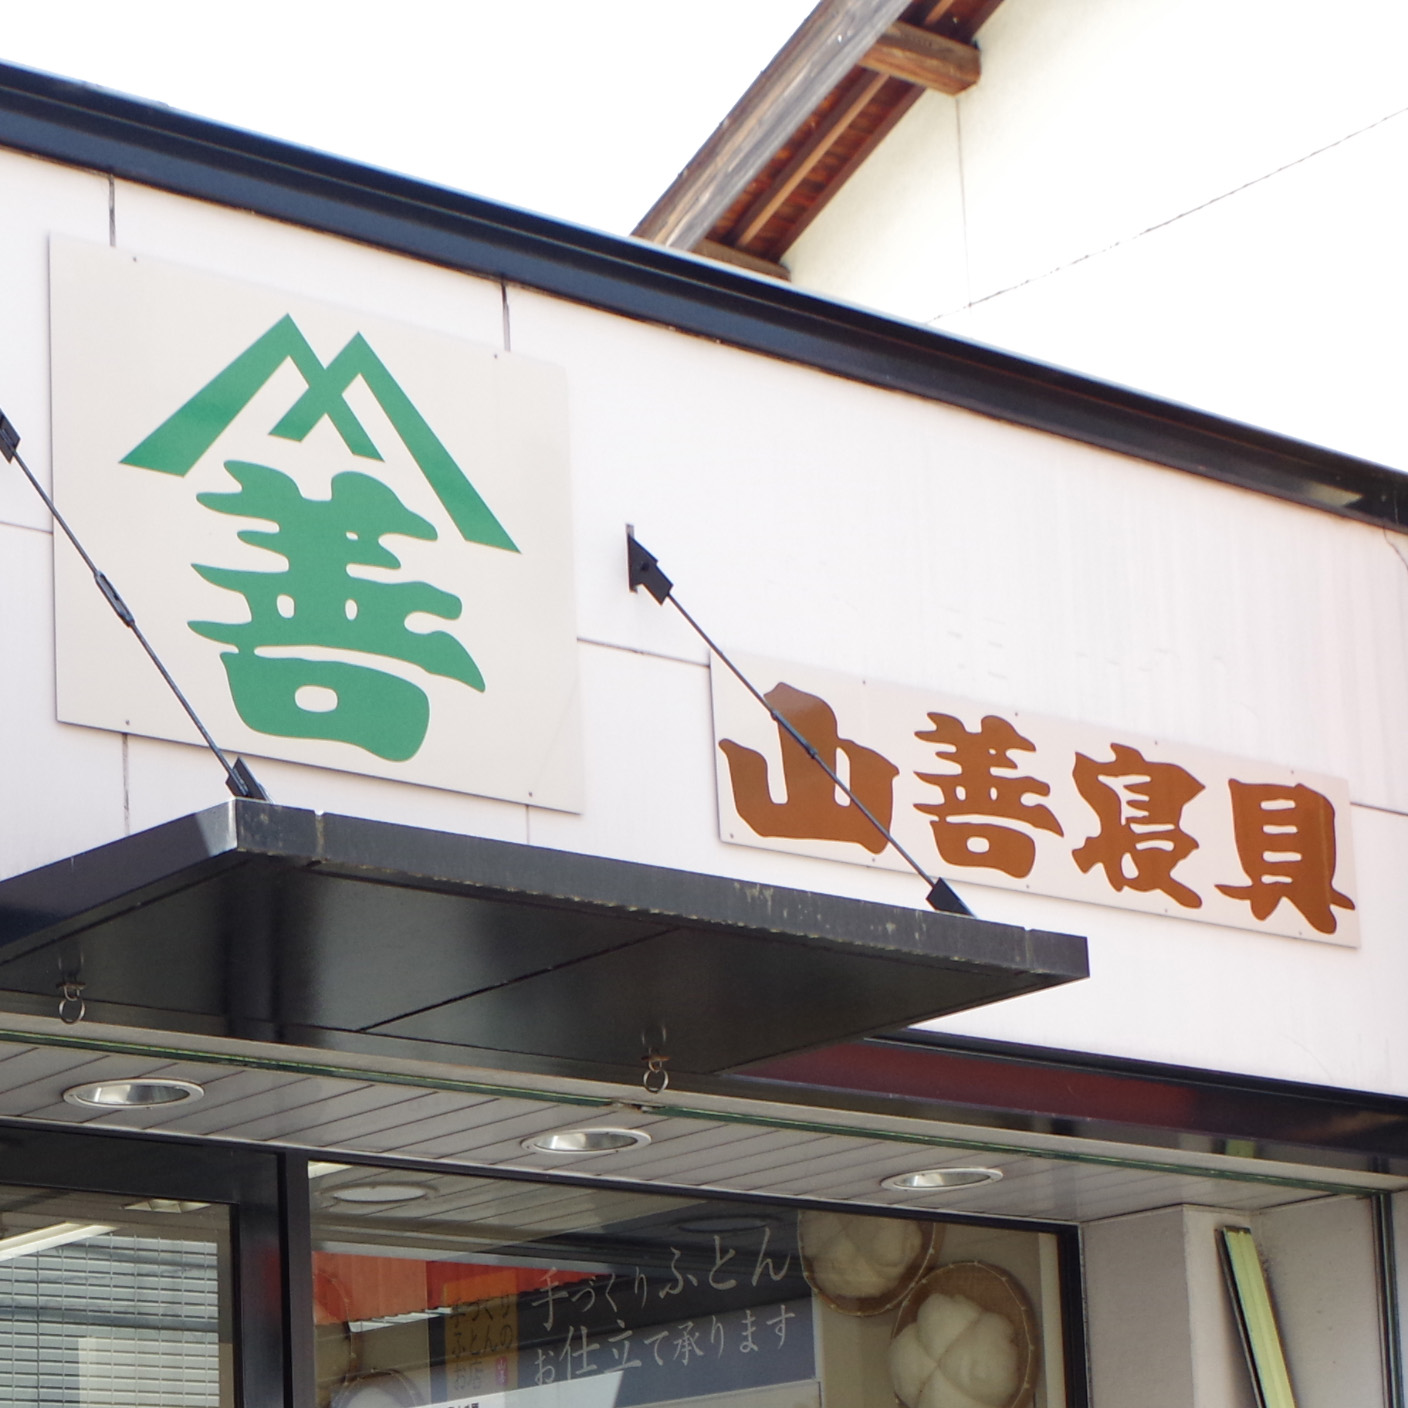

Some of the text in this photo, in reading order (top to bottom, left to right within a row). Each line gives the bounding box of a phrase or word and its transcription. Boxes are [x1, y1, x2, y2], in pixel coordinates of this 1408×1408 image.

[719, 682, 1355, 935] 山善寝具
[533, 1227, 791, 1331] 手づくりふとん
[533, 1305, 796, 1386] お仕立て承ります
